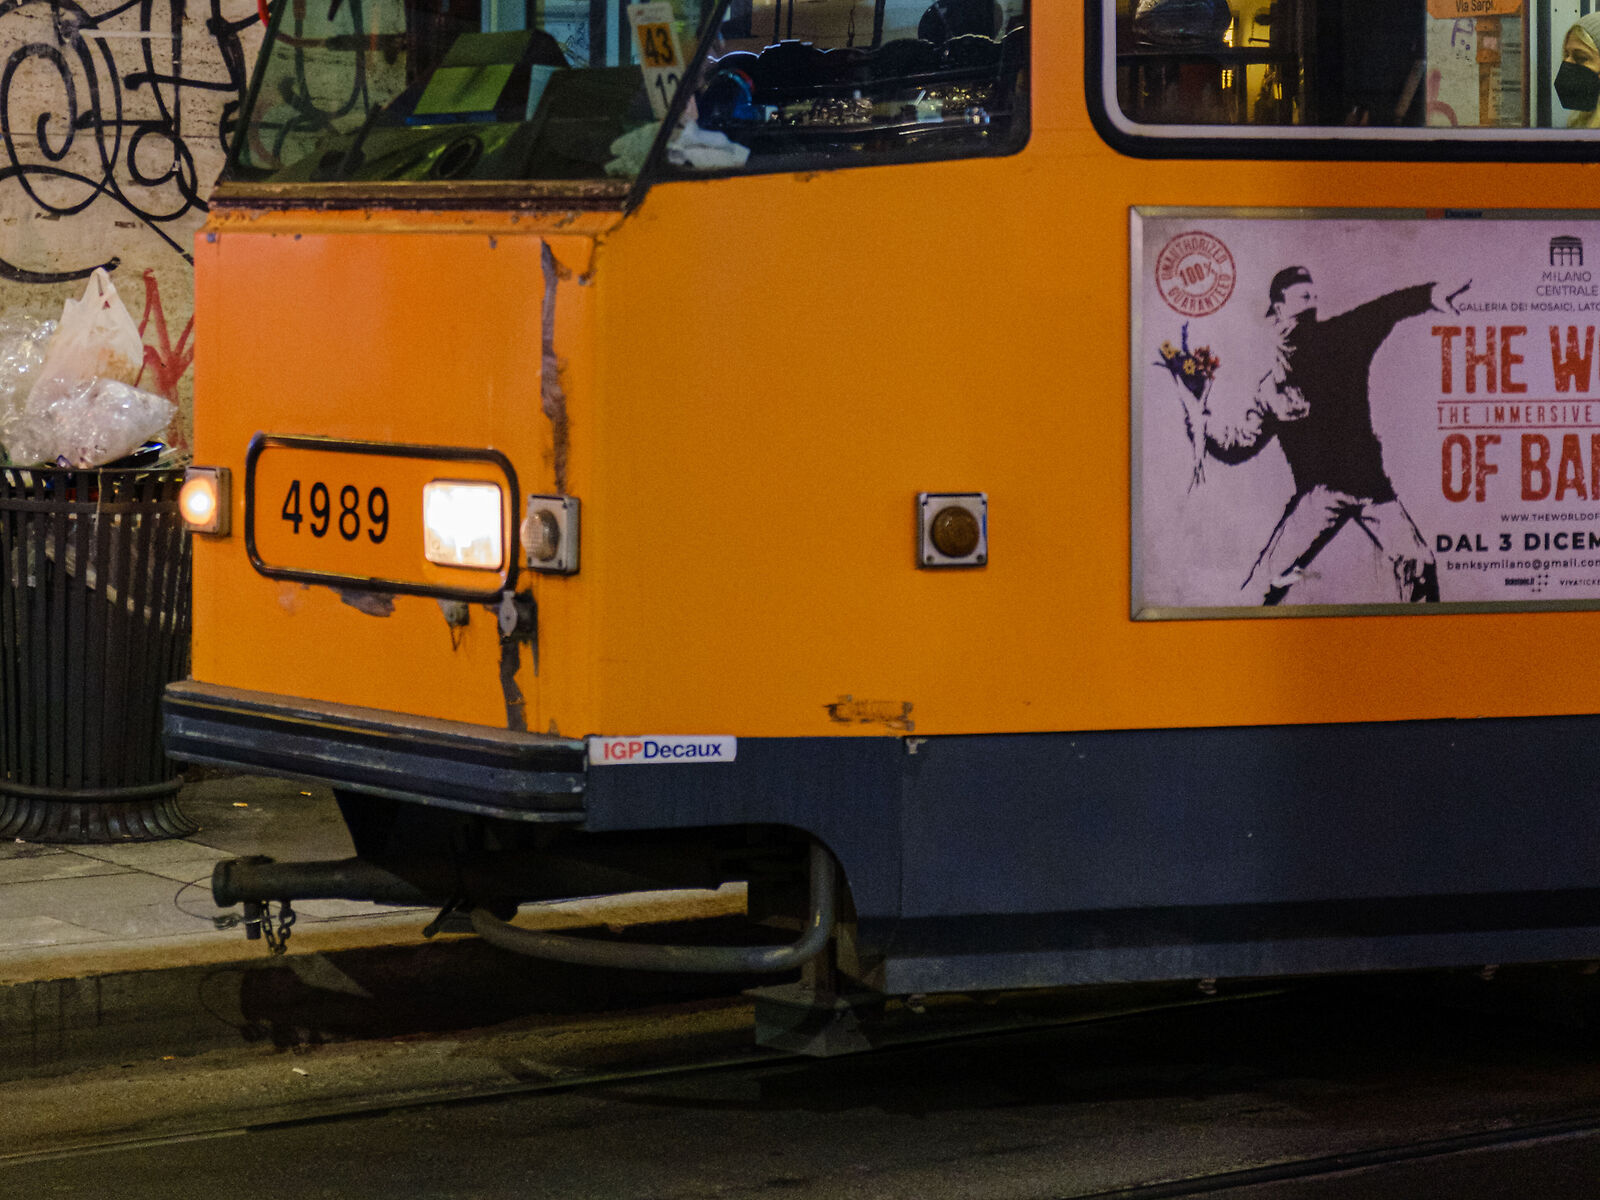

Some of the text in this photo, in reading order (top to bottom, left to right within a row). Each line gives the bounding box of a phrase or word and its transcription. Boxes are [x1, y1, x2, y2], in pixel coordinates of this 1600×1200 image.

[1456, 0, 1469, 13] Via
[646, 27, 674, 65] 43
[1180, 262, 1217, 287] 100%
[1541, 271, 1592, 282] MILANO
[1536, 285, 1600, 297] CENTRALE
[1459, 303, 1508, 312] GALLERIA
[1511, 302, 1528, 311] DEI
[1431, 325, 1600, 394] THE W
[1438, 405, 1593, 424] THE IMMERSIVE
[1442, 434, 1502, 503] OF
[282, 479, 388, 544] 4989
[1436, 534, 1489, 552] DAL
[1499, 533, 1512, 551] 3
[603, 741, 722, 760] IGPDecaux
